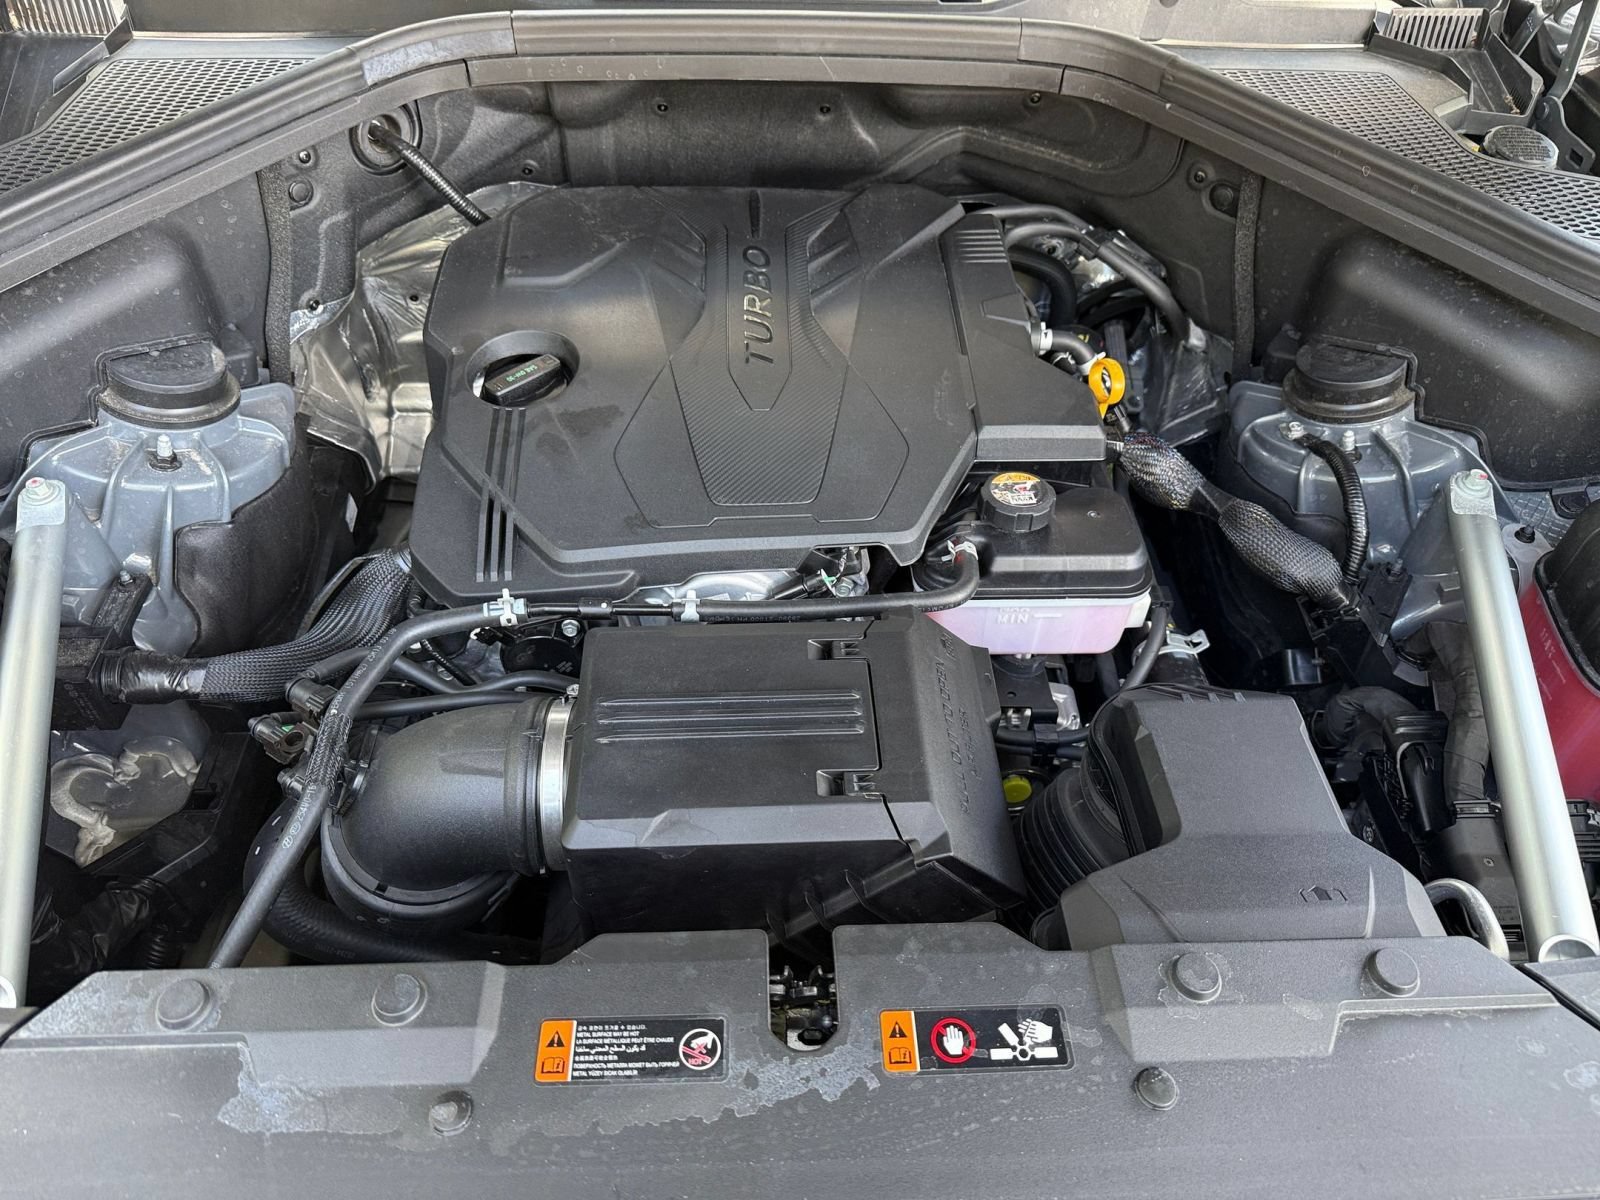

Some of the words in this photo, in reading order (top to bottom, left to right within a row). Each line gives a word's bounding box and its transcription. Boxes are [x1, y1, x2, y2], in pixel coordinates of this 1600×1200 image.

[742, 246, 774, 365] TURBO
[997, 613, 1029, 624] MIN
[934, 655, 951, 701] OPEN
[942, 702, 953, 724] TO
[946, 728, 961, 765] OUT
